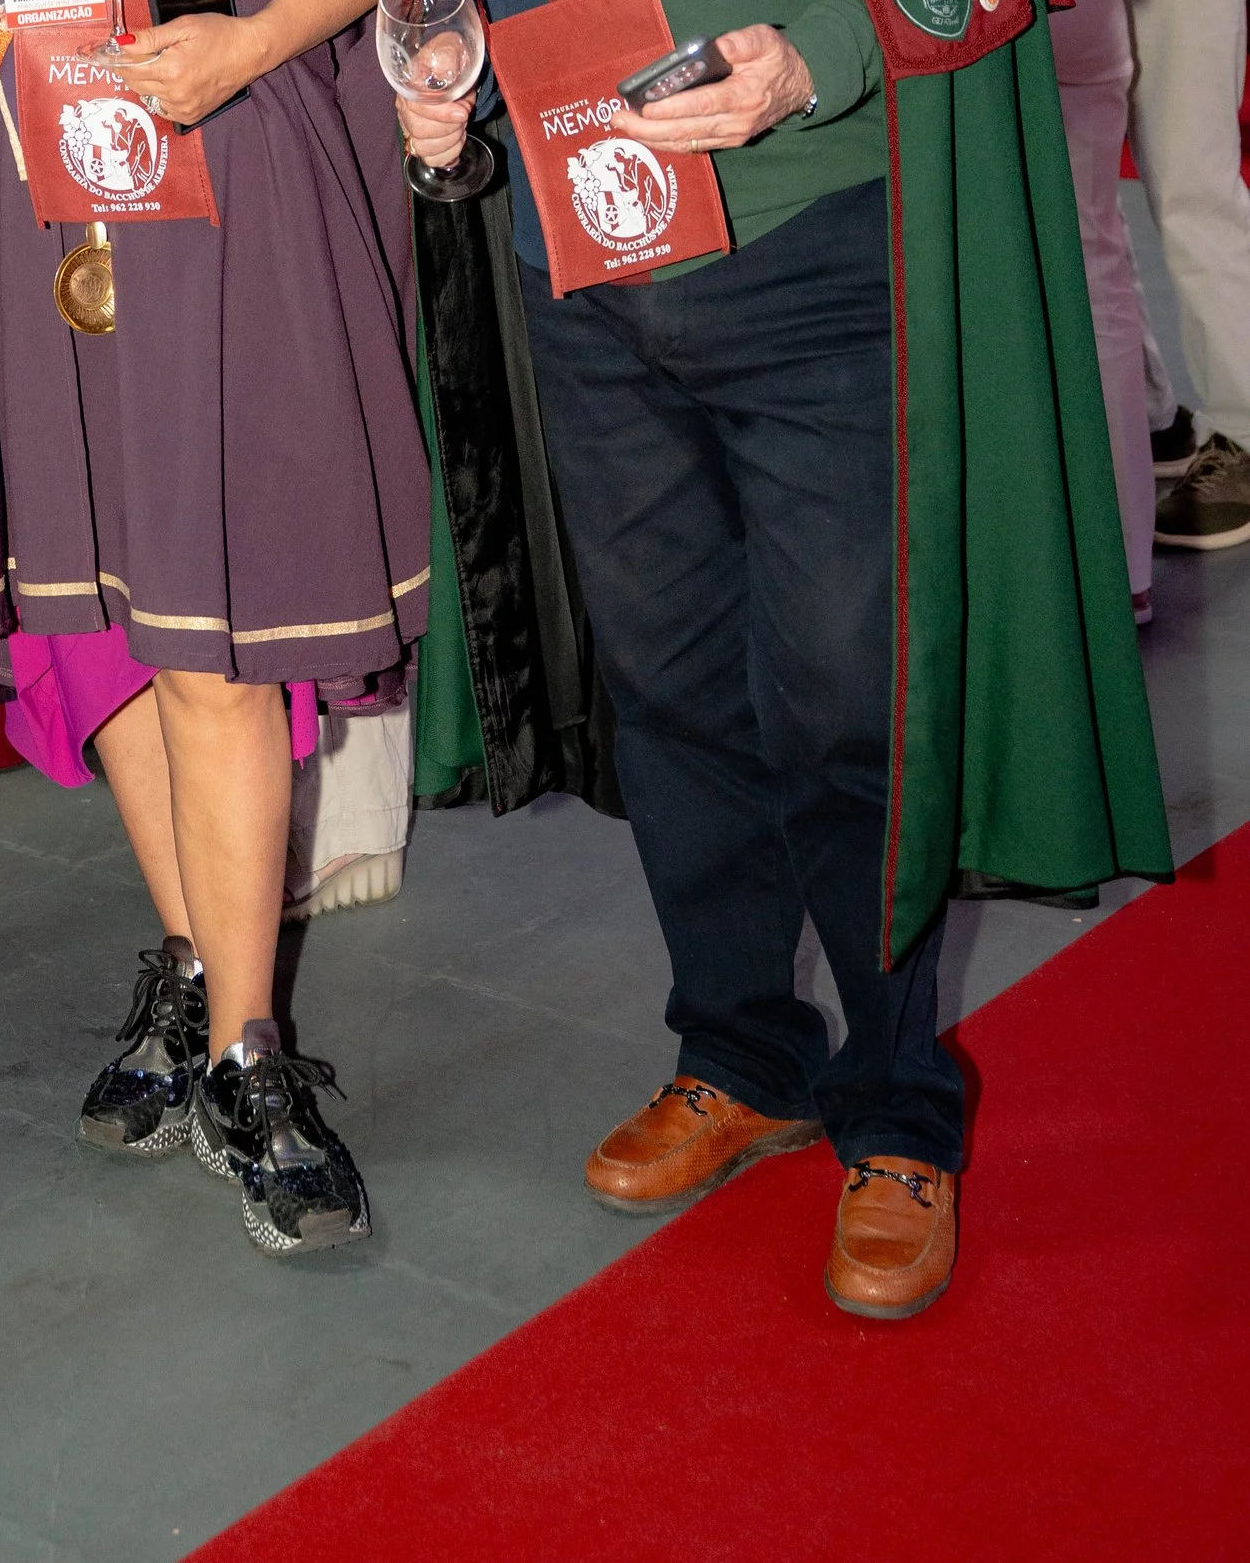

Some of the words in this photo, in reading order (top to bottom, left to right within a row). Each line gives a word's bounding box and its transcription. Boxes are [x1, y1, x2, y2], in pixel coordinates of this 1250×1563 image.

[17, 5, 93, 25] ORGANIZAÇÃO
[539, 99, 589, 119] RESTAURANTE
[58, 139, 89, 190] CONFRARIA
[89, 186, 103, 197] DO
[104, 187, 145, 202] BACCHUS
[144, 183, 155, 194] DE
[153, 135, 168, 186] ALBUFEIRA
[91, 203, 109, 213] Tel:
[110, 203, 126, 212] 962
[128, 202, 144, 211] 228
[144, 202, 160, 211] 930
[572, 194, 604, 244] CONFRARIA
[602, 238, 615, 250] DO
[616, 232, 657, 251] BACCHUS
[655, 221, 668, 235] DE
[665, 164, 678, 224] ALBUFEIRA
[604, 256, 621, 270] Tel:
[622, 252, 638, 266] 962
[639, 249, 655, 262] 228
[655, 243, 671, 257] 930
